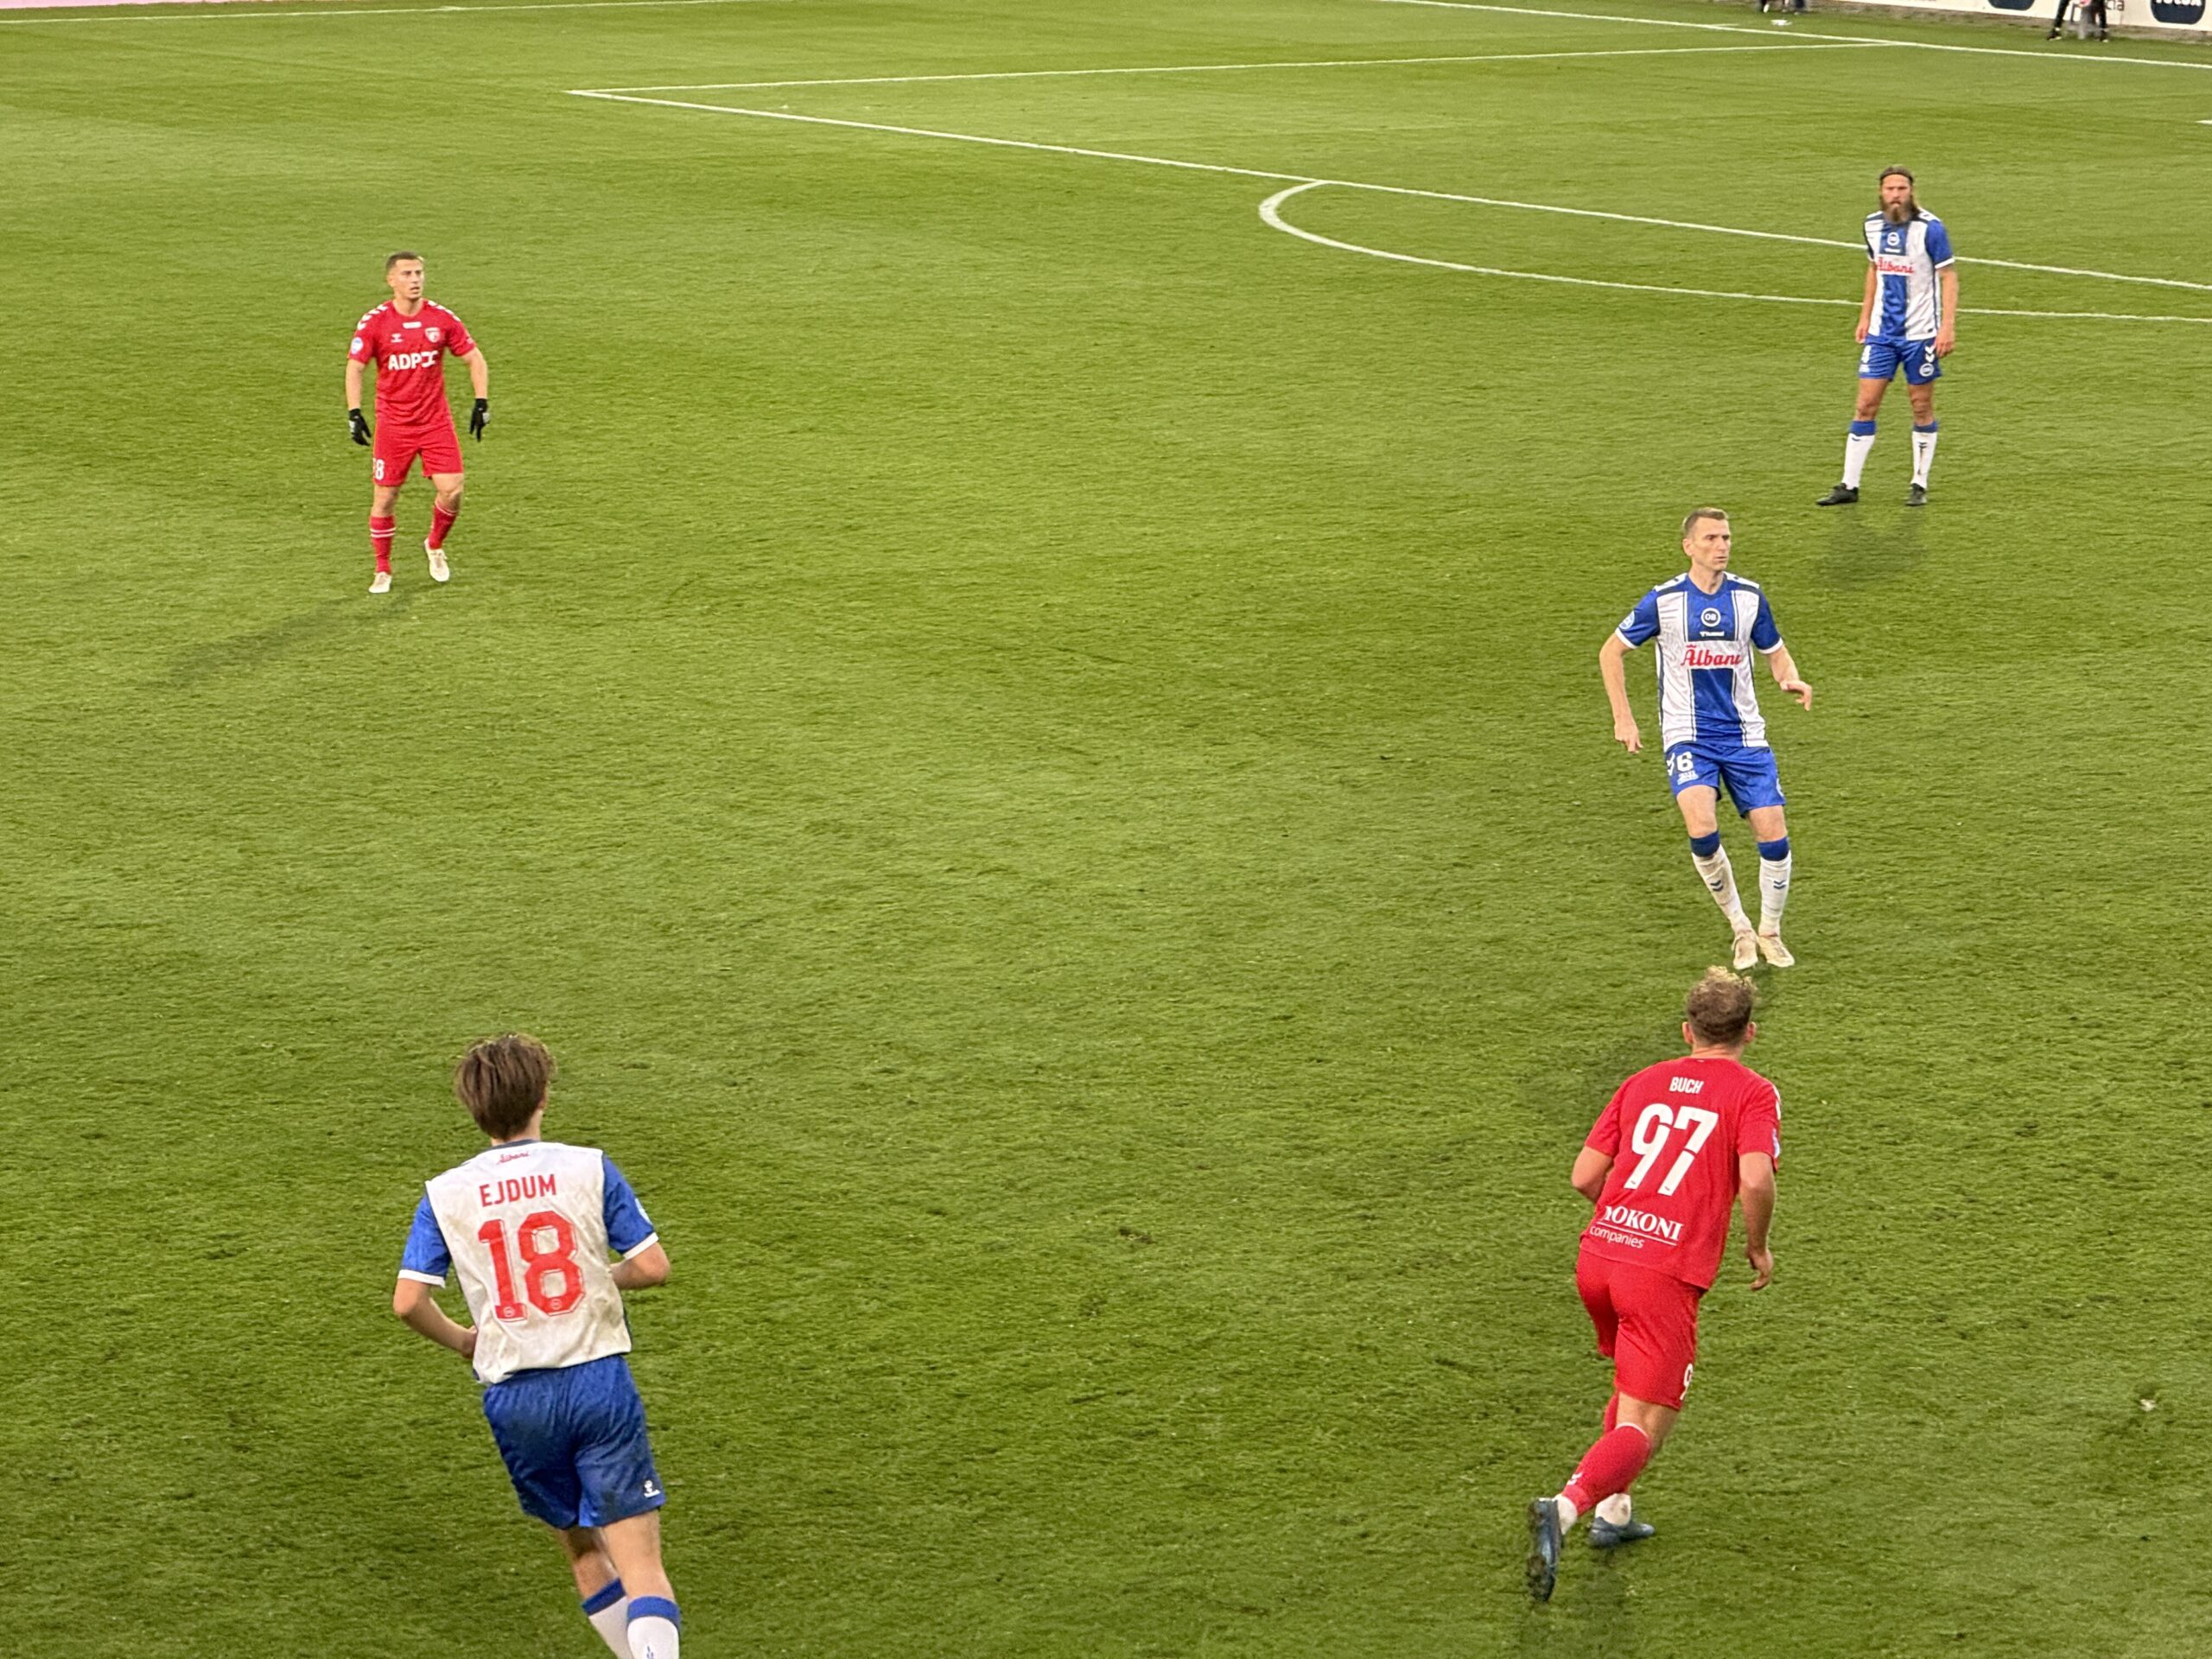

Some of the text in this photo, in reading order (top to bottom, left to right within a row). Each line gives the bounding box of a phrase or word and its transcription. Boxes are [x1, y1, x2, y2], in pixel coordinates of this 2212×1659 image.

[1681, 645, 1742, 666] Albani
[1669, 1077, 1704, 1094] BUCH
[1624, 1103, 1719, 1197] 97
[479, 1173, 556, 1207] EJDUM
[1590, 1225, 1644, 1249] companies
[478, 1211, 586, 1322] 18
